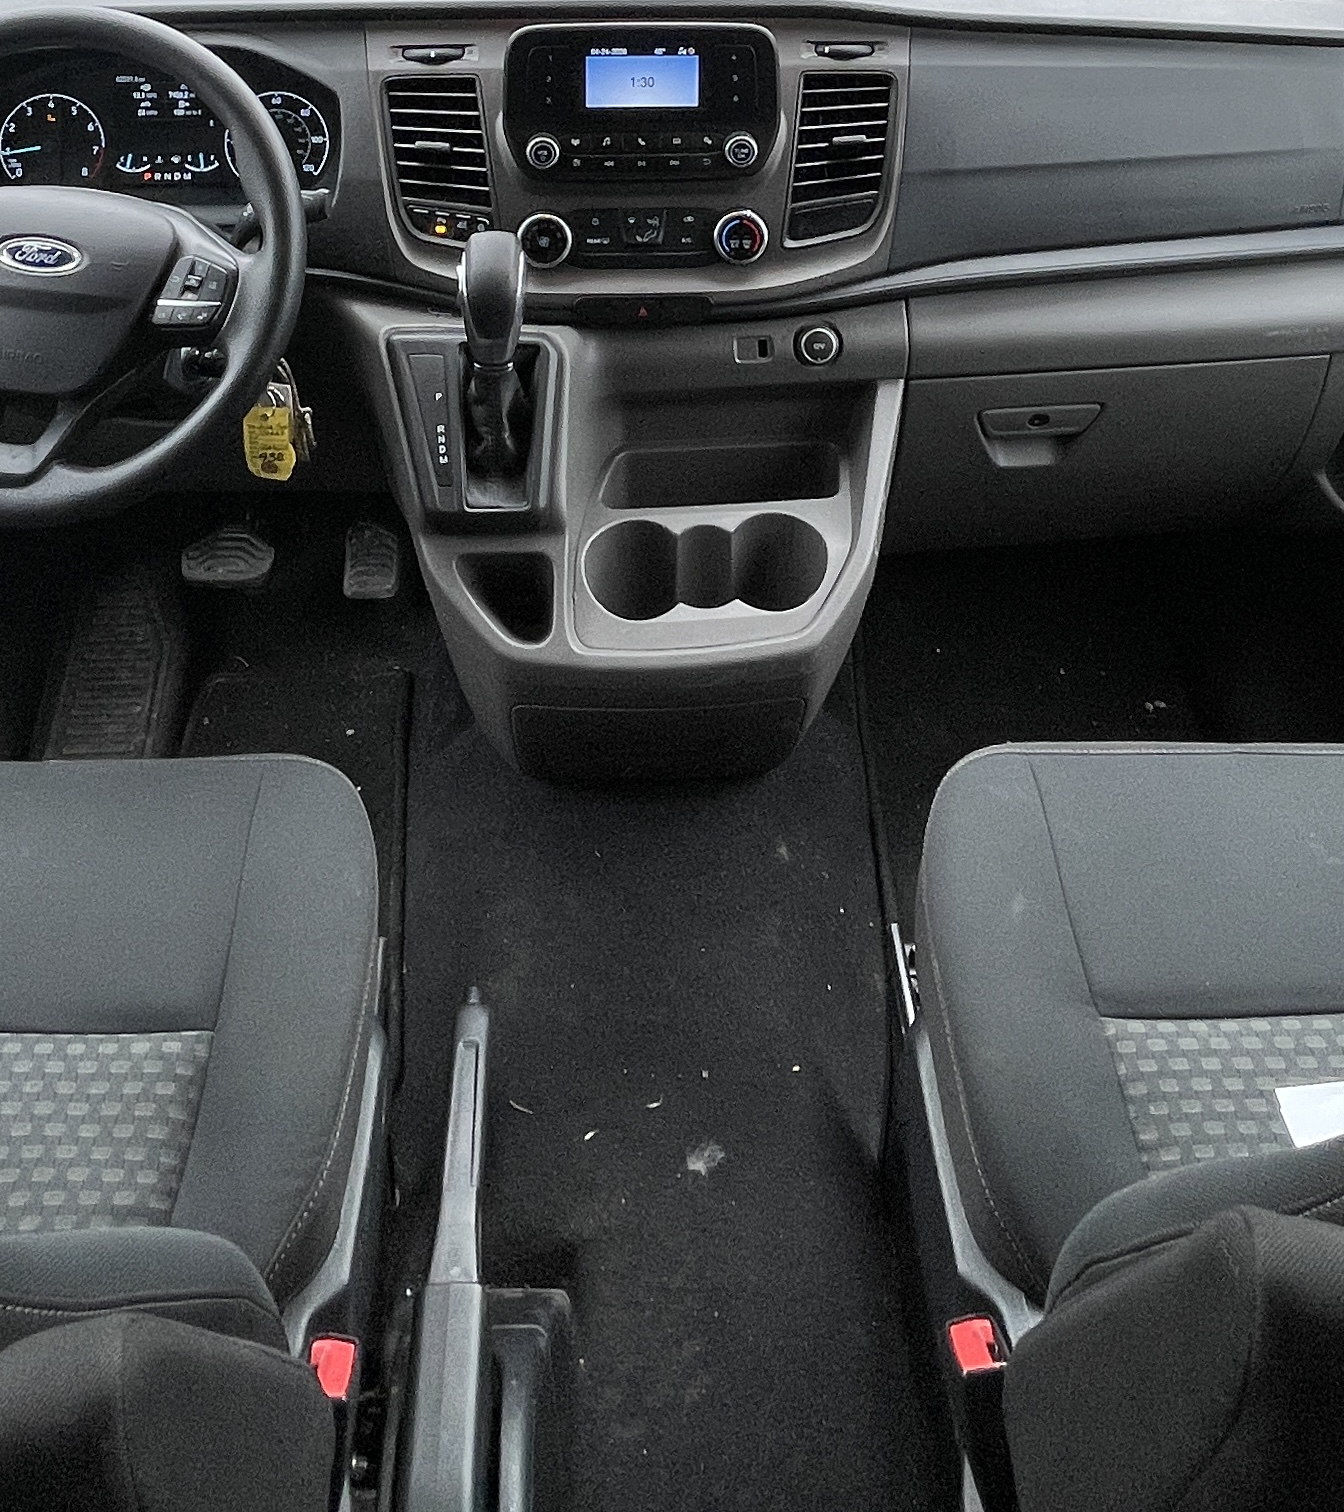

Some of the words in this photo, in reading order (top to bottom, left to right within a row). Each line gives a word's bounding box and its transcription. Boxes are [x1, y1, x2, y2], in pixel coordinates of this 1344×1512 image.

[630, 76, 655, 88] 1:30
[47, 100, 55, 108] 4
[26, 106, 33, 116] 3
[71, 106, 78, 116] 5
[8, 122, 16, 132] 2
[87, 122, 94, 132] 6
[92, 146, 100, 155] 7
[144, 172, 152, 181] P
[154, 172, 162, 180] R
[164, 172, 172, 180] N
[174, 172, 182, 180] D
[14, 243, 61, 265] Ford
[435, 392, 442, 401] P
[436, 425, 445, 433] R
[438, 435, 446, 444] N
[438, 446, 447, 454] D
